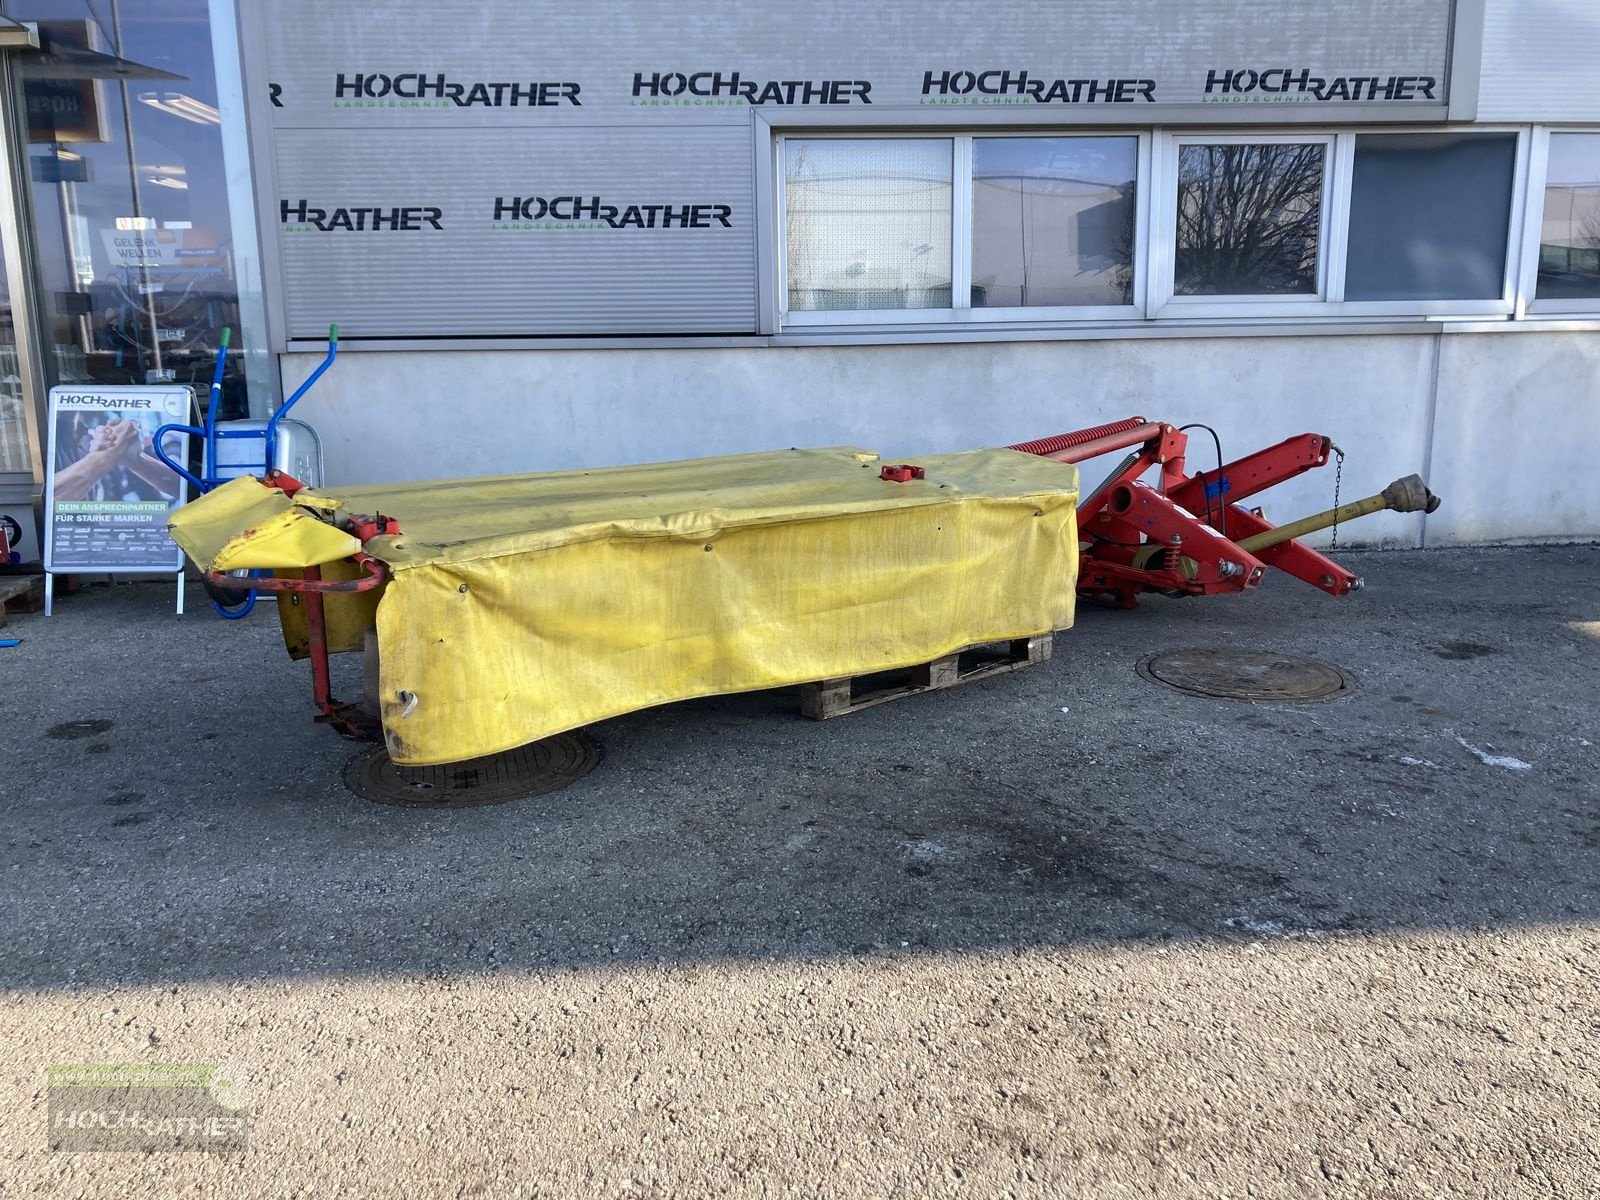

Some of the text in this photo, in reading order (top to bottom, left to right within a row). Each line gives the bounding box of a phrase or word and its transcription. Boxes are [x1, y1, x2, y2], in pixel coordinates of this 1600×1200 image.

[336, 73, 582, 107] HOCHRATHER
[632, 72, 872, 105] HOCHRATHER
[922, 70, 1156, 103] HOCHRATHER
[1204, 68, 1436, 101] HOCHRATHER
[334, 100, 450, 108] LANDTECHNIK
[1202, 95, 1311, 103] LANDTECHNIK
[280, 199, 443, 231] HRATHER
[493, 196, 732, 229] HOCHRATHER
[492, 222, 604, 230] LANDTECHNIK
[114, 238, 156, 247] GELENK
[117, 249, 162, 258] WELLEN
[59, 395, 151, 408] HOCHRATHER
[58, 503, 166, 511] DEIN ANSPRECHPARTNER
[55, 513, 153, 522] FÜR STARKE MARKEN
